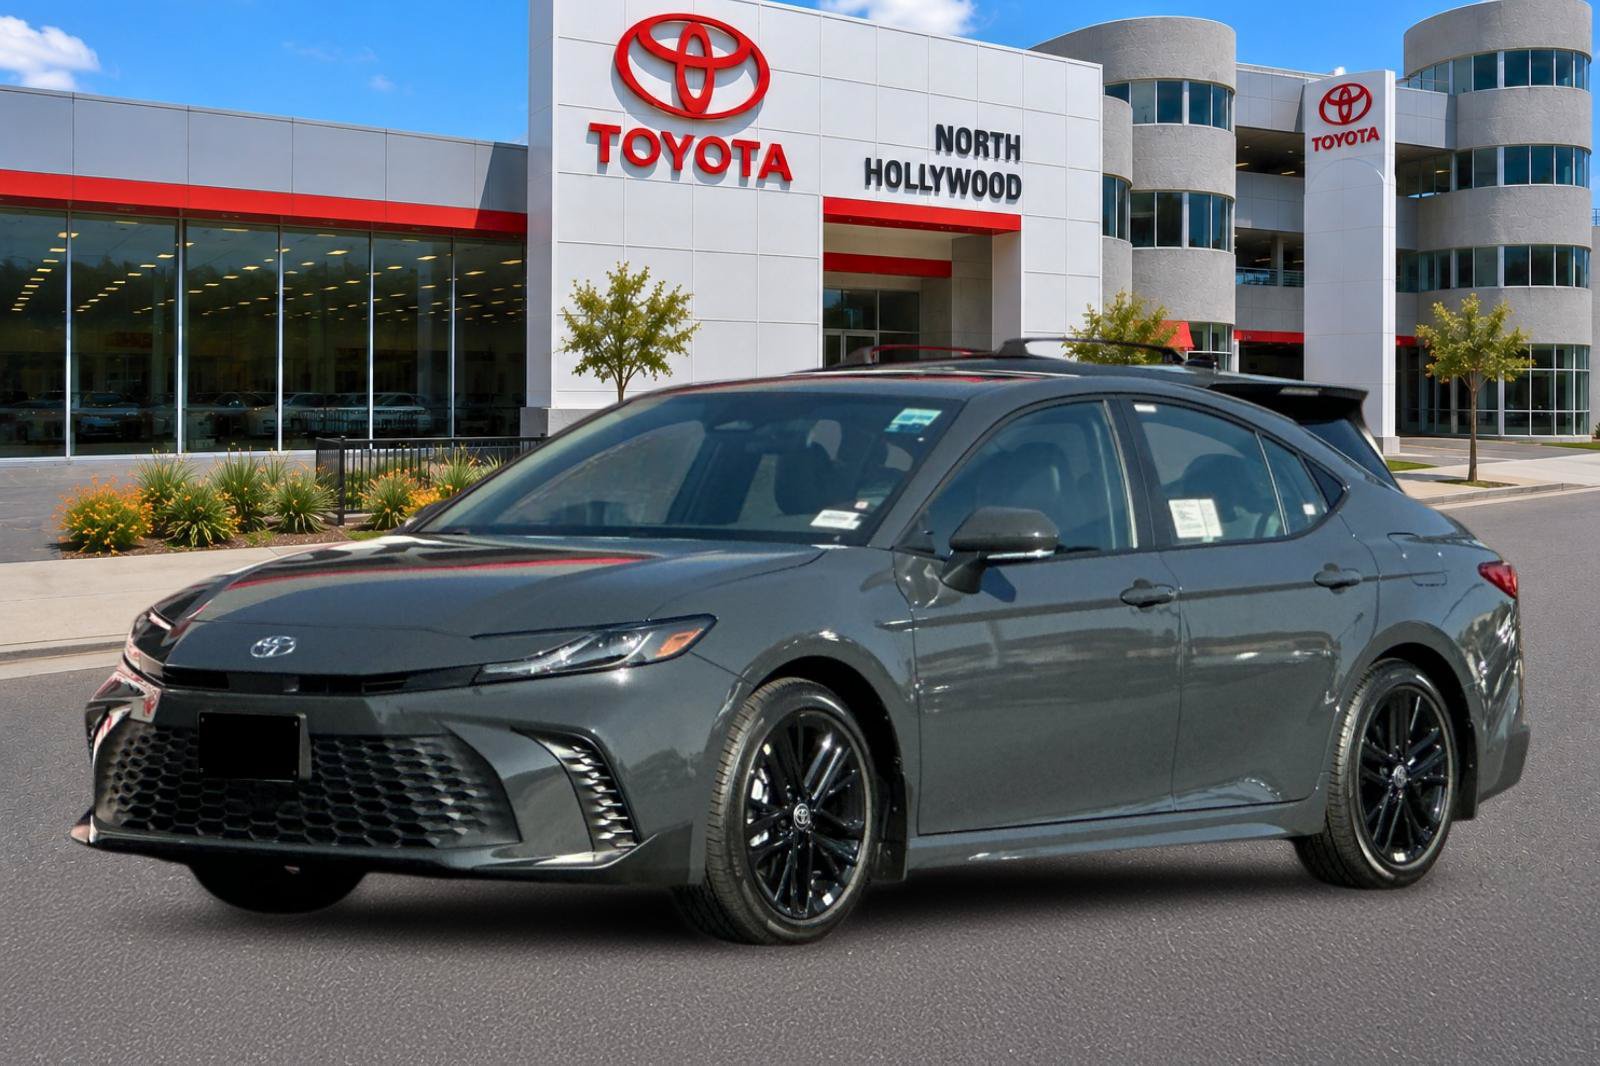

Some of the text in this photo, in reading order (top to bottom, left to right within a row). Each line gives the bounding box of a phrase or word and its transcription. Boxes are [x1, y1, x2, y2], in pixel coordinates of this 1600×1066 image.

[588, 122, 793, 182] TOYOTA
[935, 124, 1021, 161] NORTH
[1312, 127, 1380, 151] TOYOTA
[865, 157, 1022, 200] HOLLYWOOD
